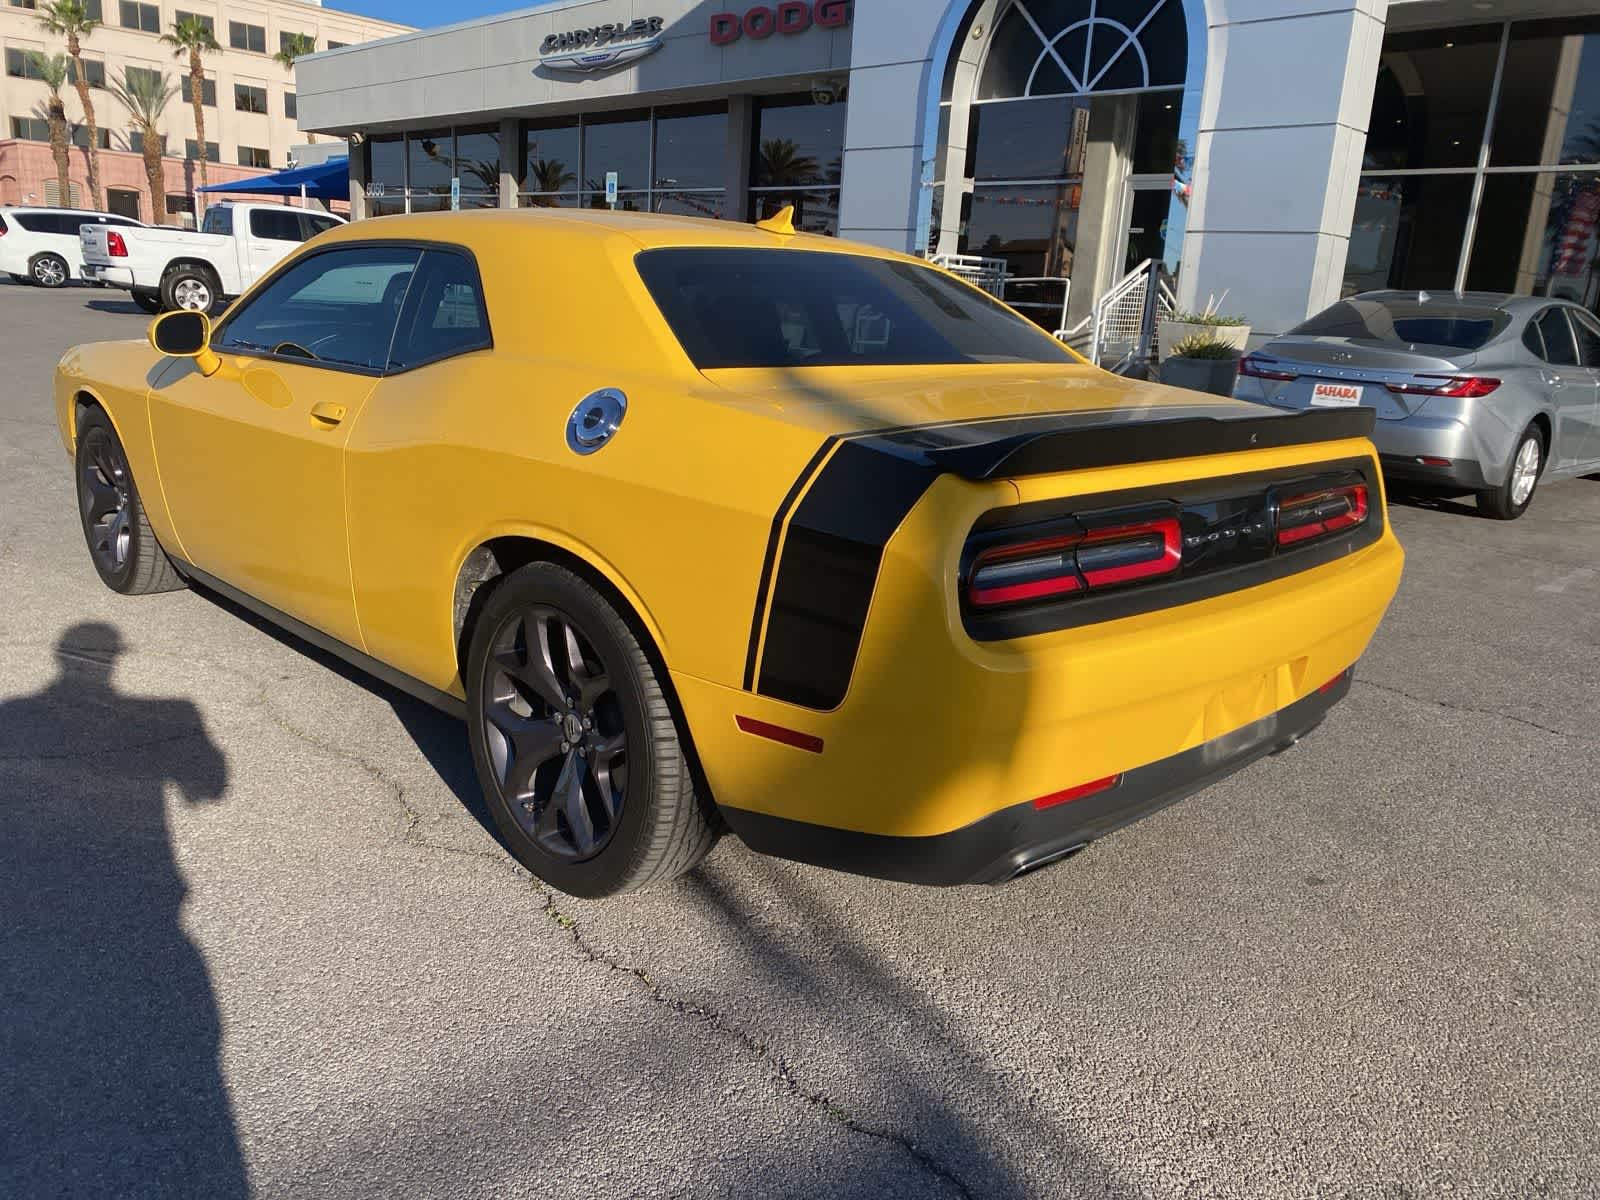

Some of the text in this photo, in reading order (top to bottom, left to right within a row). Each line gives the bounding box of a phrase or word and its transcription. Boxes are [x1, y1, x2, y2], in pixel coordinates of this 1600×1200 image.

[540, 16, 664, 54] CHRYSLER
[709, 0, 847, 43] DODG
[1315, 385, 1359, 399] SAHARA
